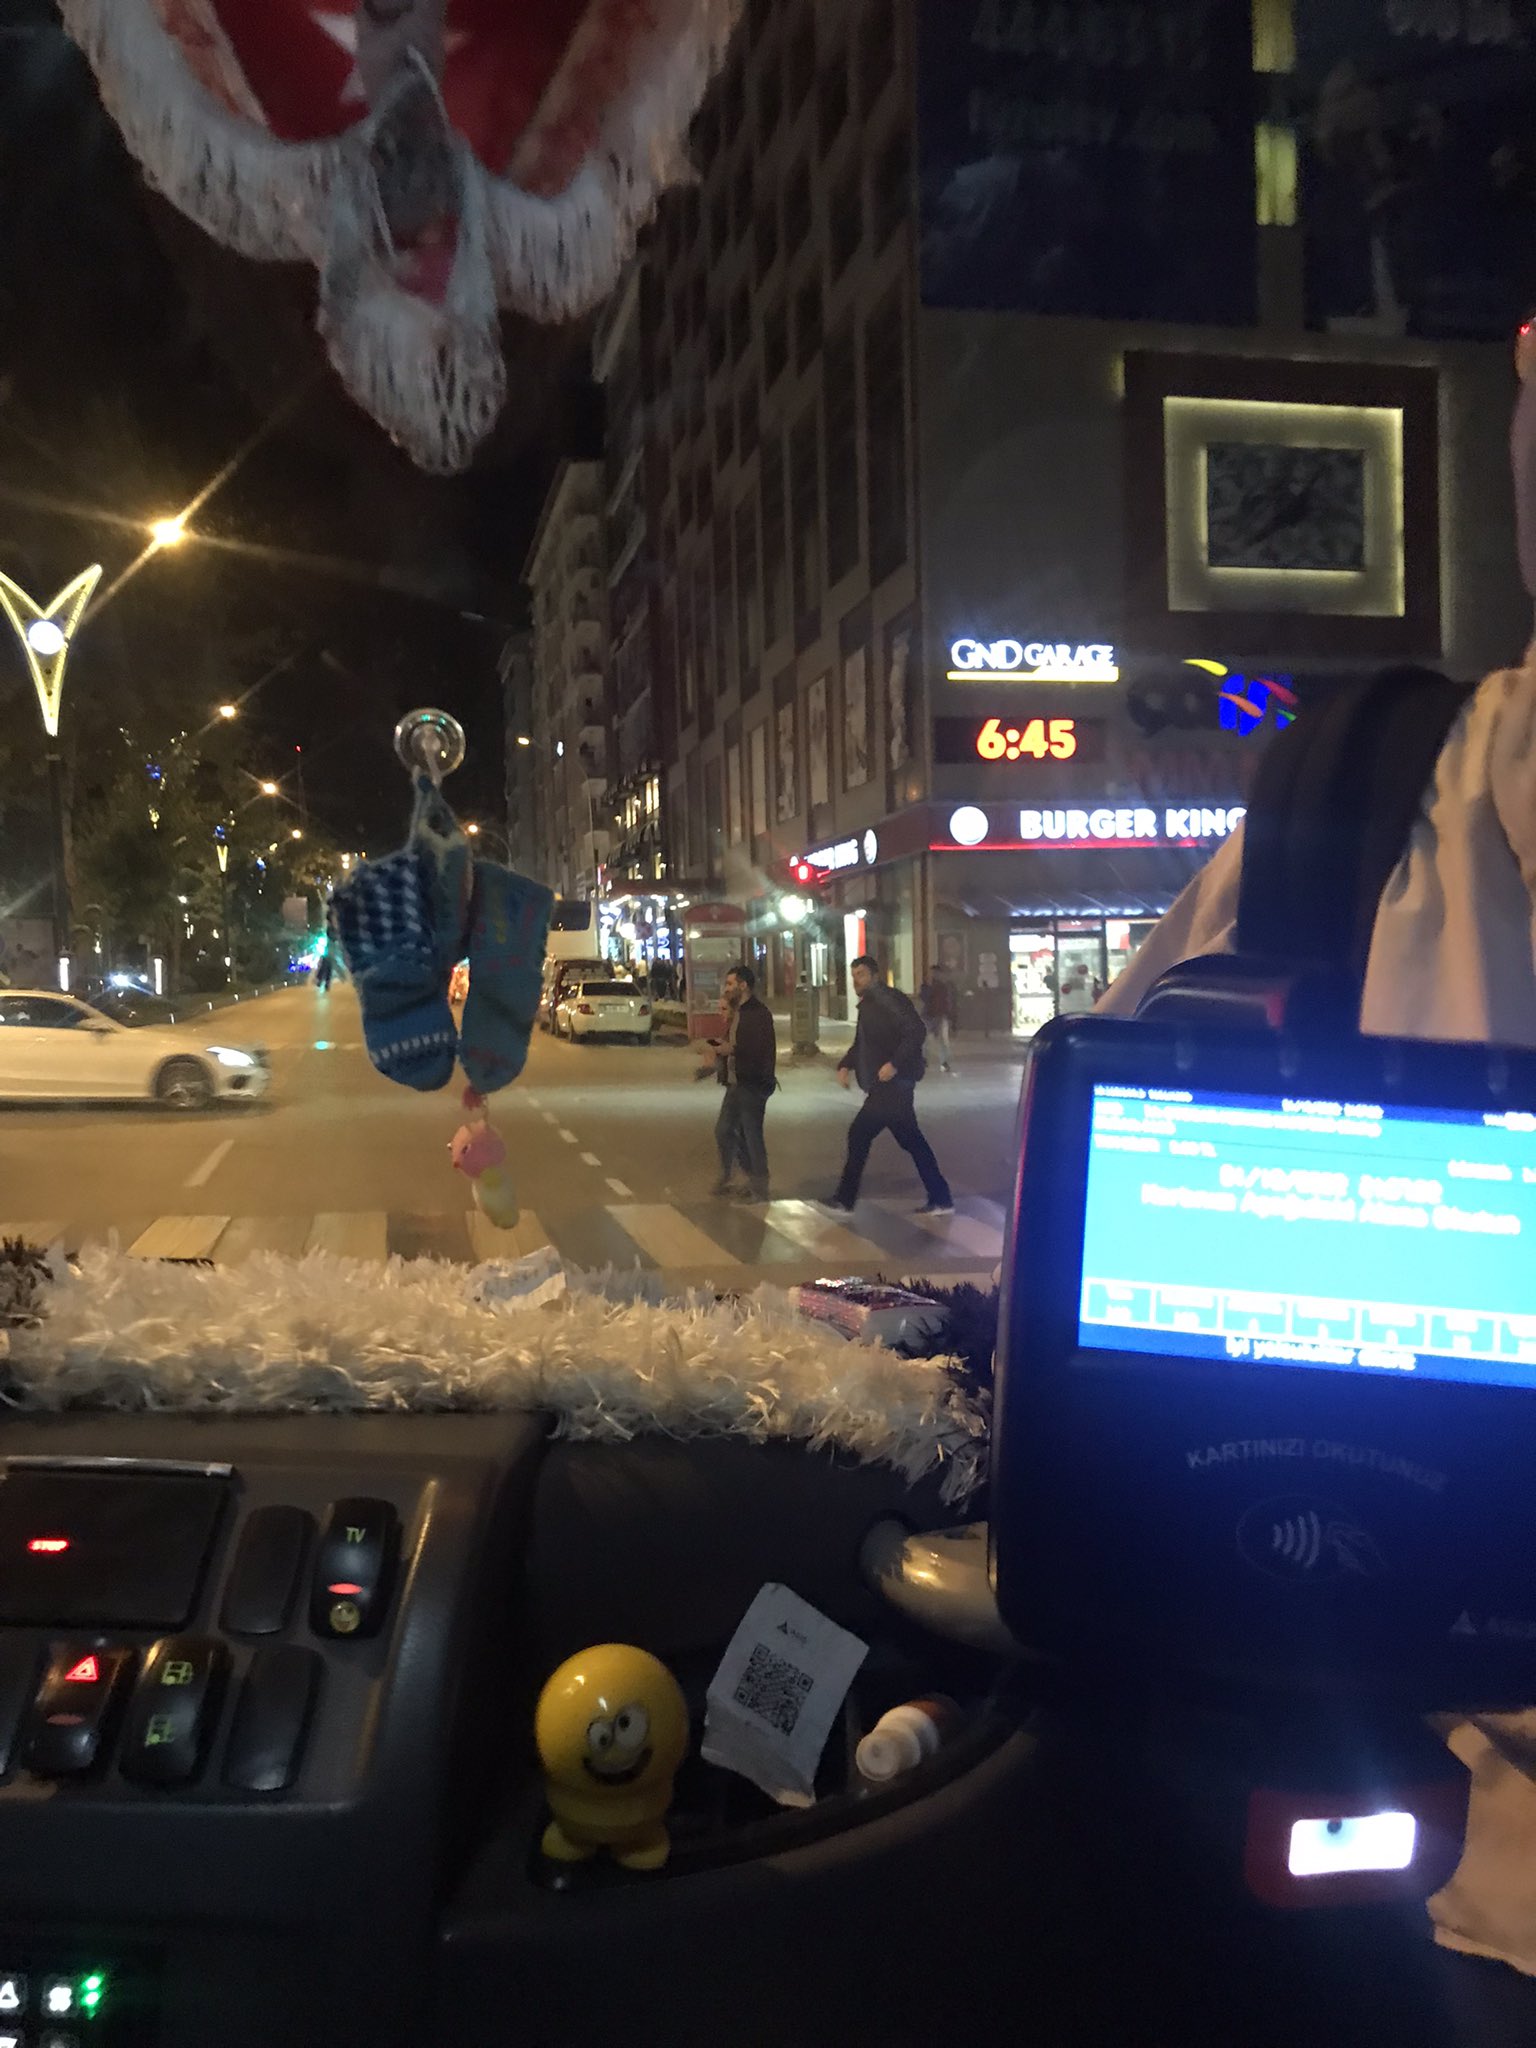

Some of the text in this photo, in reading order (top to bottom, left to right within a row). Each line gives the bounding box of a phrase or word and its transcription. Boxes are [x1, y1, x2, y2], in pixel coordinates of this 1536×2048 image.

[950, 638, 1114, 669] GND GARAGE
[976, 718, 1077, 761] 6:45
[1019, 808, 1158, 840] BURGER
[346, 1526, 366, 1543] TV
